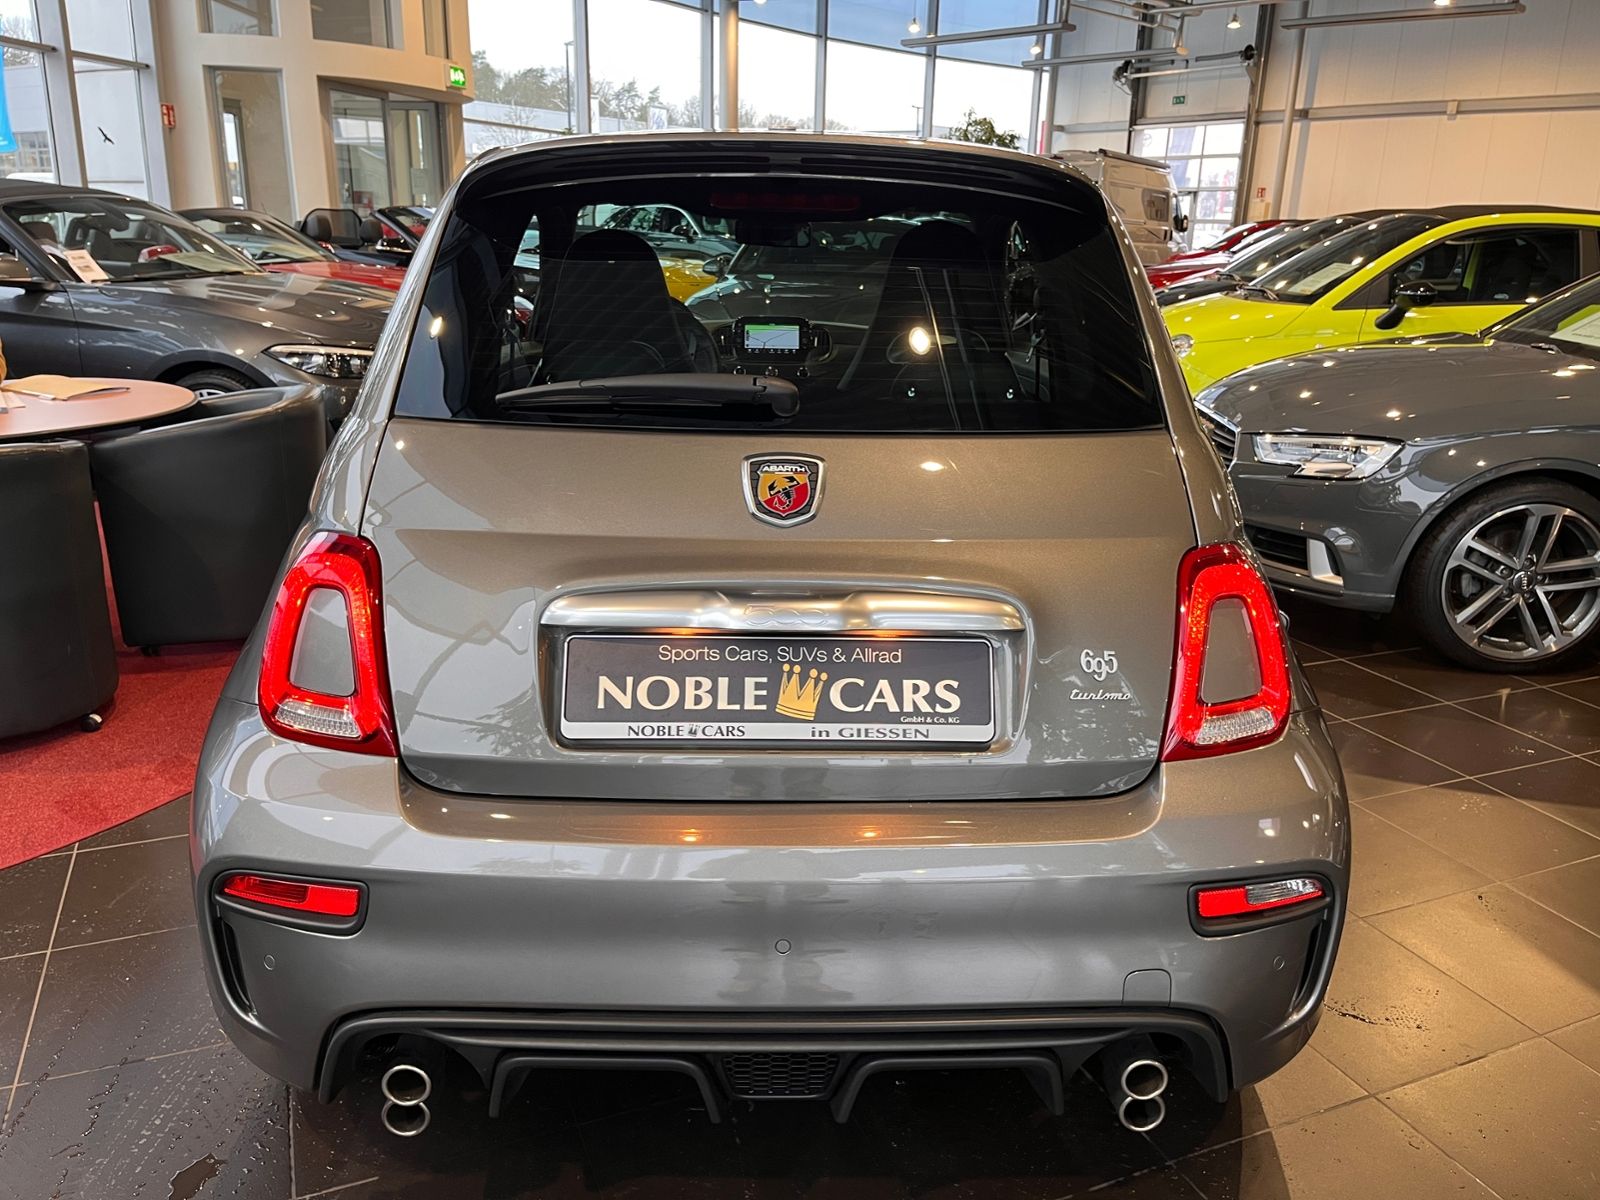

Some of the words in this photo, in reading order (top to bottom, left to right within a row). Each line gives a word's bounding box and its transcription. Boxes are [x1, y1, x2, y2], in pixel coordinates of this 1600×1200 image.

[762, 464, 806, 472] ABARTH
[658, 645, 720, 663] Sports
[725, 646, 773, 663] Cars,
[776, 646, 828, 662] SUVs
[832, 647, 847, 663] &
[850, 648, 902, 663] Allrad
[1080, 648, 1118, 682] 695
[597, 675, 769, 710] NOBLE
[829, 677, 961, 713] CARS
[1069, 688, 1131, 701] turismo
[900, 716, 924, 724] GmbH
[926, 716, 933, 724] &
[934, 716, 947, 724] Co.
[627, 725, 684, 736] NOBLE
[702, 726, 746, 737] CARS
[811, 727, 830, 738] in
[838, 727, 930, 739] GIESSEN
